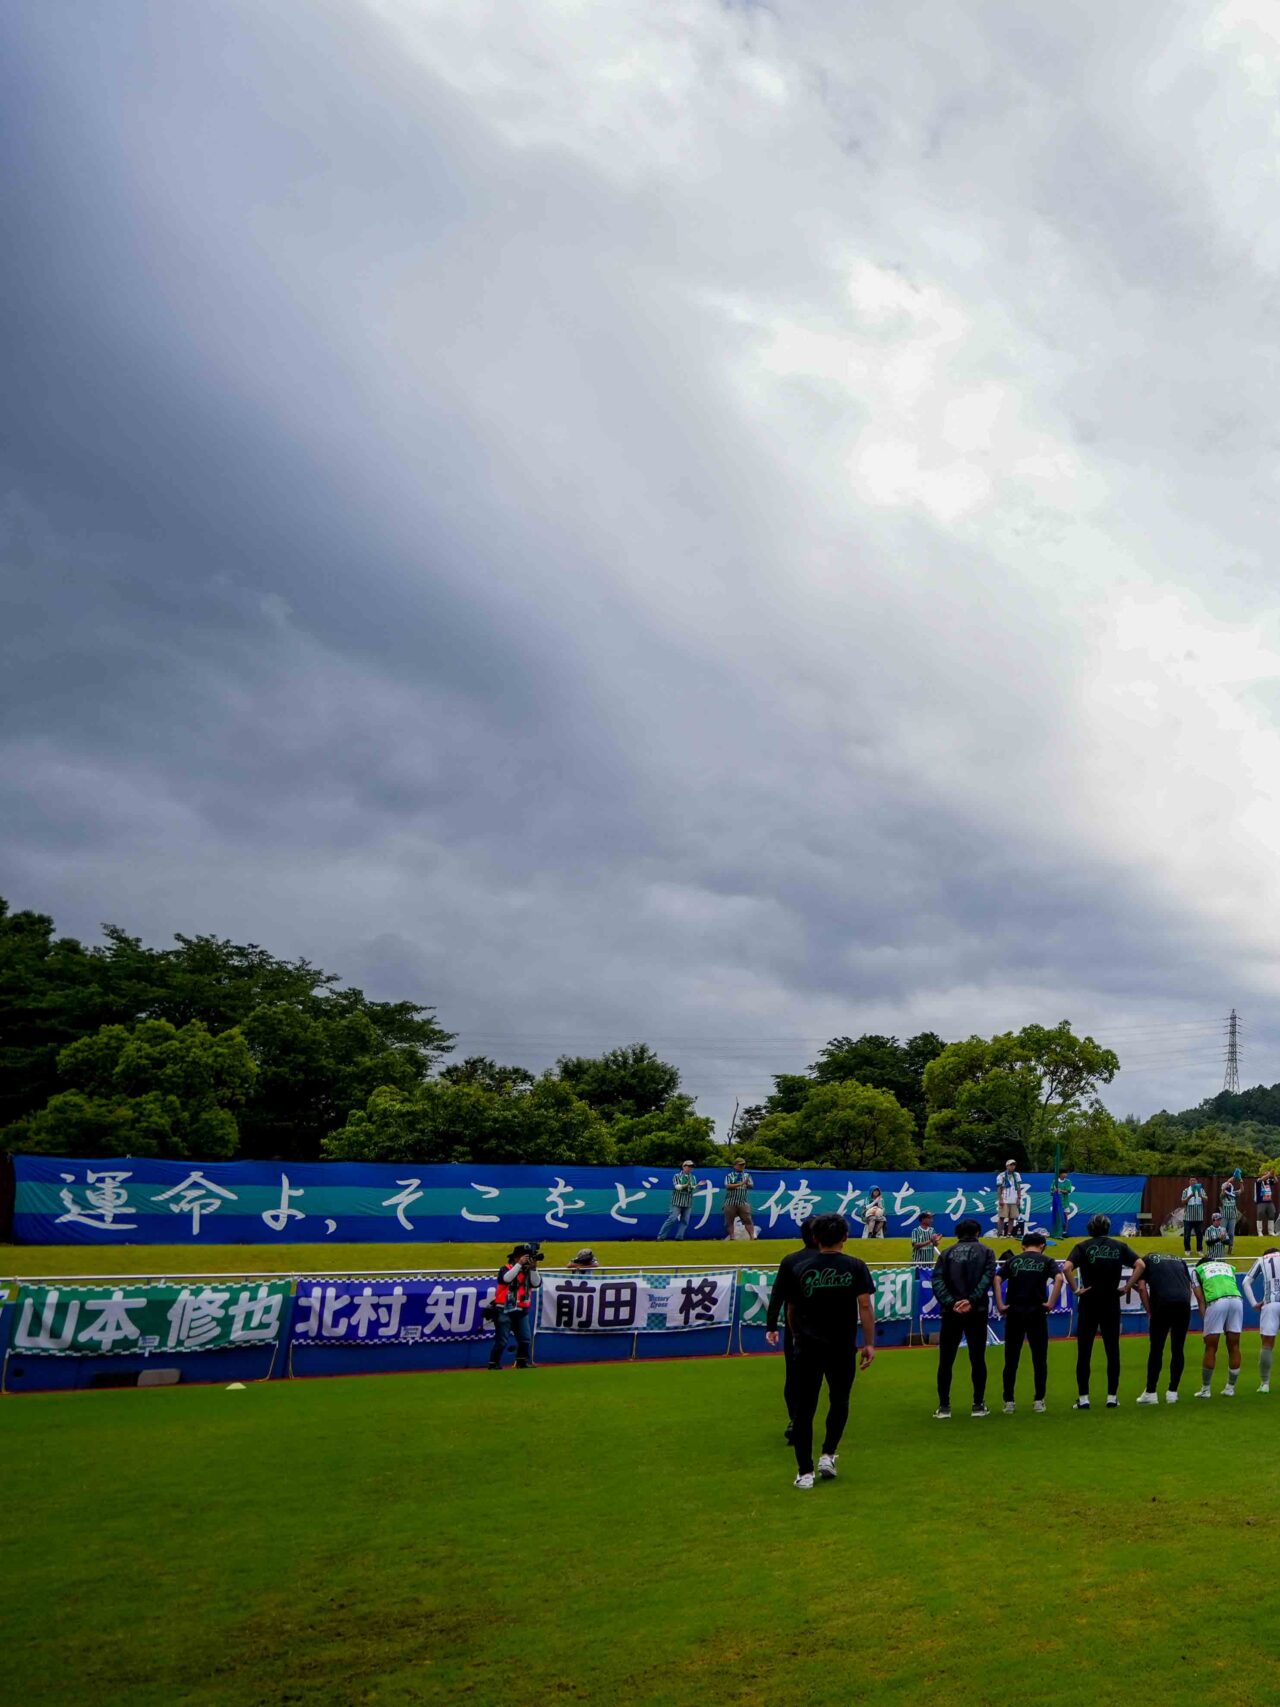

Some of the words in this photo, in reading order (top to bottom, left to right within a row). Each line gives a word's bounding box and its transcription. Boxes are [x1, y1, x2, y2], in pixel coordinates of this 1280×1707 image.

[14, 1290, 147, 1350] 山本
[166, 1286, 283, 1348] 修也
[295, 1286, 407, 1338] 北村
[555, 1280, 638, 1328] 前田
[679, 1278, 718, 1325] 柊
